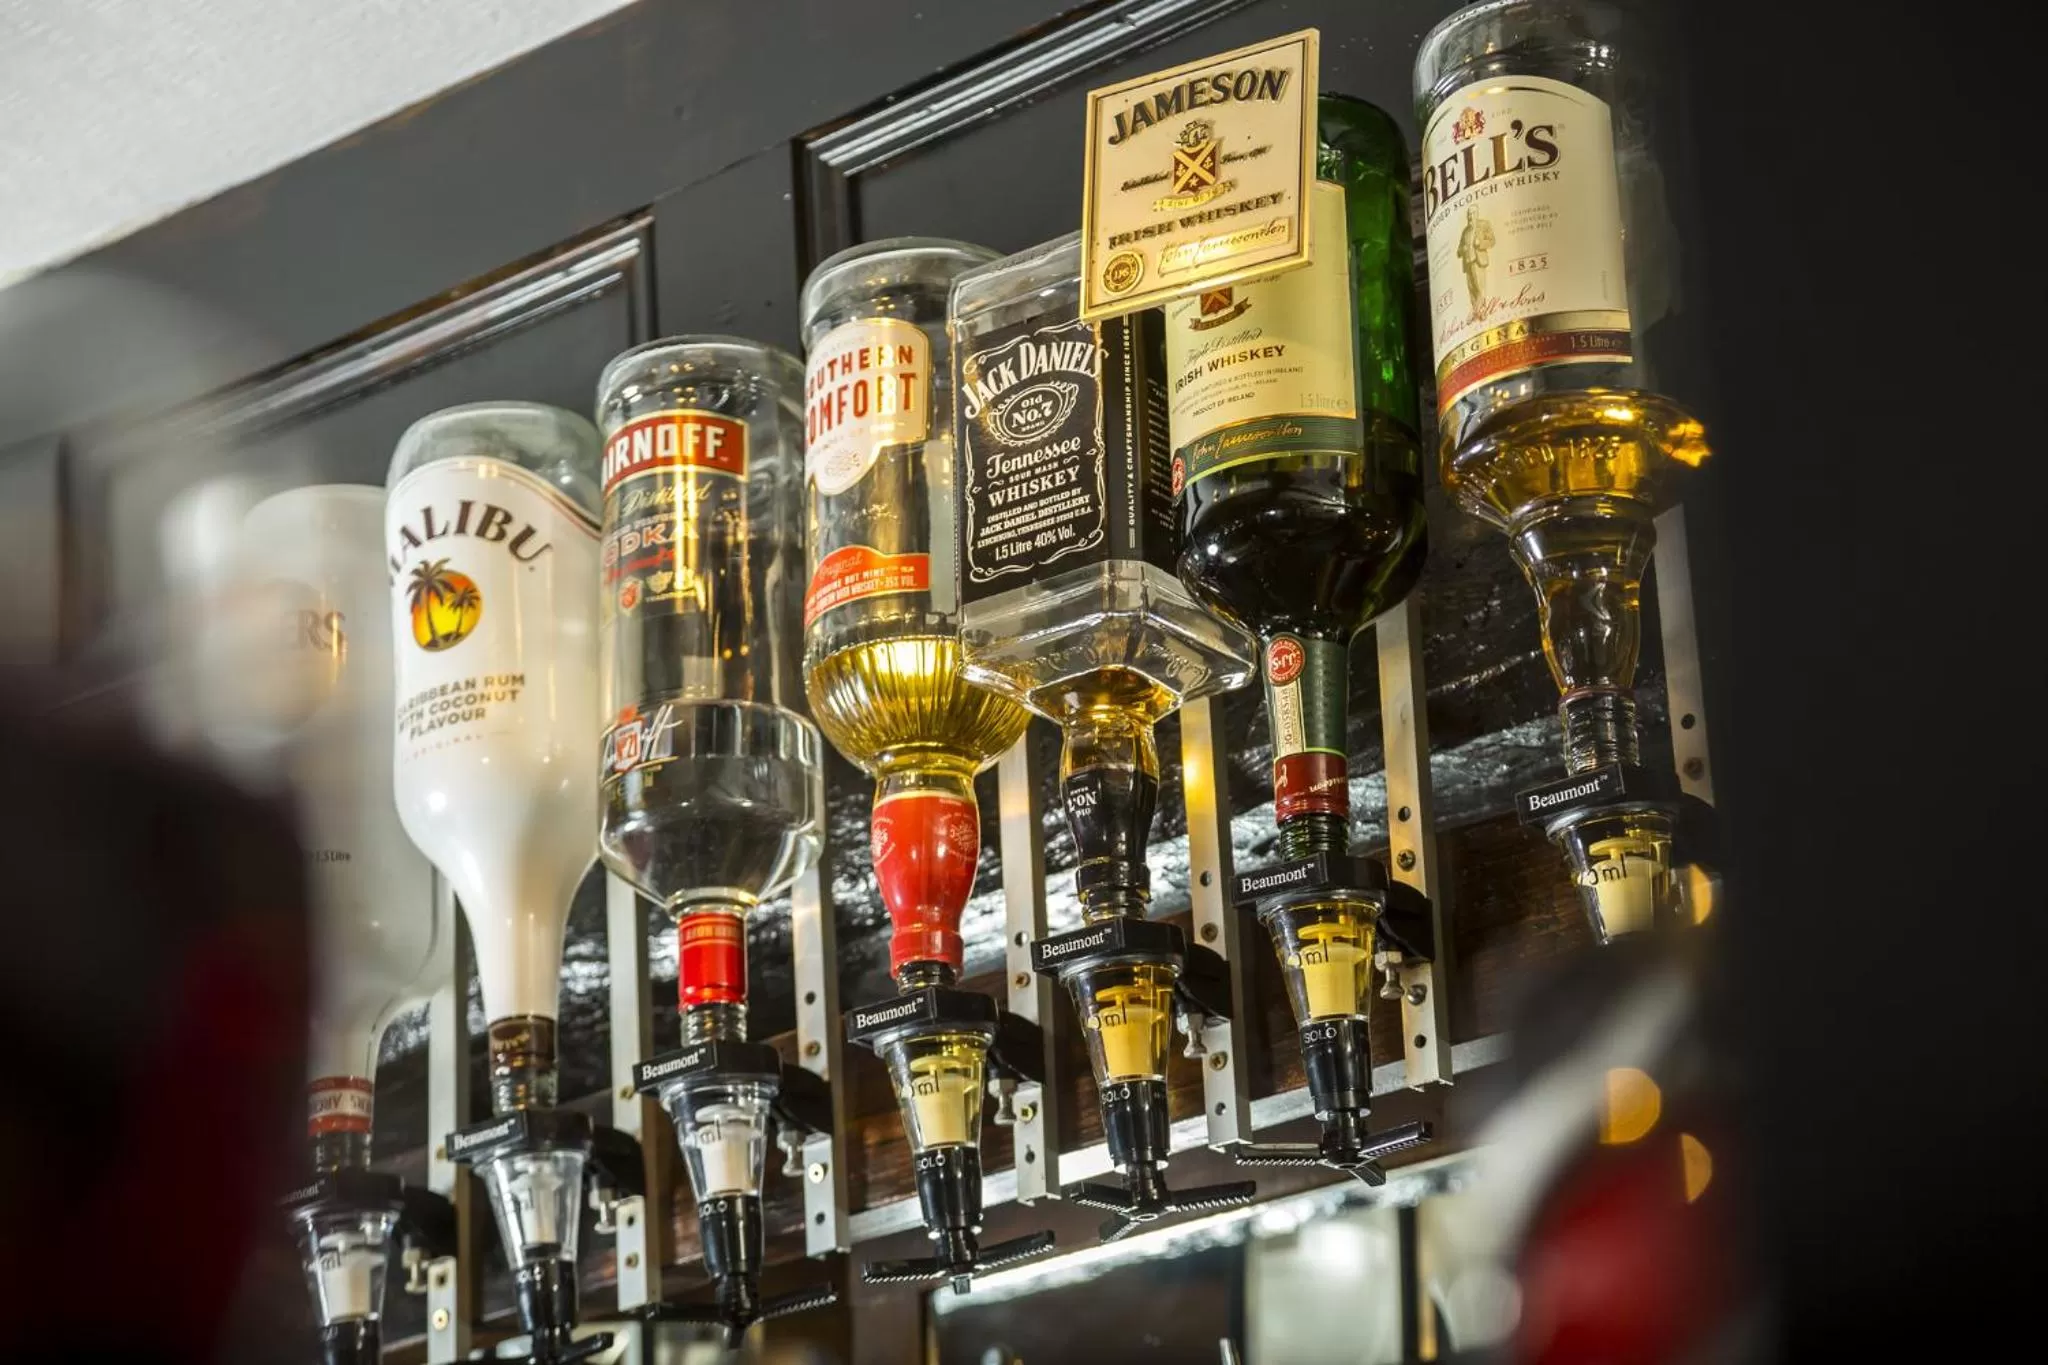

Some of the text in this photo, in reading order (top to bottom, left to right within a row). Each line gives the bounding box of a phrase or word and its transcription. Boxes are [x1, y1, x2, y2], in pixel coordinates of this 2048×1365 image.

[1108, 69, 1290, 146] JAMESON
[1424, 119, 1560, 223] BELL'S
[1453, 184, 1498, 209] SCOTCH
[1503, 171, 1560, 189] WHISKY
[1109, 220, 1175, 249] IRISH
[1179, 192, 1284, 229] WHISKEY
[1509, 257, 1548, 272] 1825
[1510, 283, 1545, 307] Sons
[962, 357, 1020, 419] JACK
[1175, 344, 1286, 394] IRISH WHISKEY
[808, 372, 917, 445] OMFORT
[1021, 394, 1042, 408] Old
[1227, 391, 1255, 404] IRELAND
[1125, 386, 1133, 470] CRAFTSMANSHIP
[602, 424, 724, 490] IRNOFF
[986, 437, 1080, 479] Tennessee
[988, 465, 1081, 508] WHISKEY
[1023, 502, 1038, 512] AND
[1039, 491, 1070, 506] BOTTLED
[1127, 481, 1135, 526] QUALITY
[980, 523, 1003, 537] JACK
[1004, 512, 1036, 529] DANIEL
[1038, 495, 1090, 518] DISTILLERY
[1010, 540, 1033, 556] Litre
[1034, 529, 1057, 548] 40%
[1058, 524, 1076, 540] Vol.
[484, 674, 525, 688] RUM
[429, 690, 520, 715] COCONUT
[409, 707, 486, 742] FLAVOUR
[1303, 1027, 1337, 1044] SOLO
[1102, 1087, 1130, 1105] SOLO
[917, 1154, 945, 1172] SOLO
